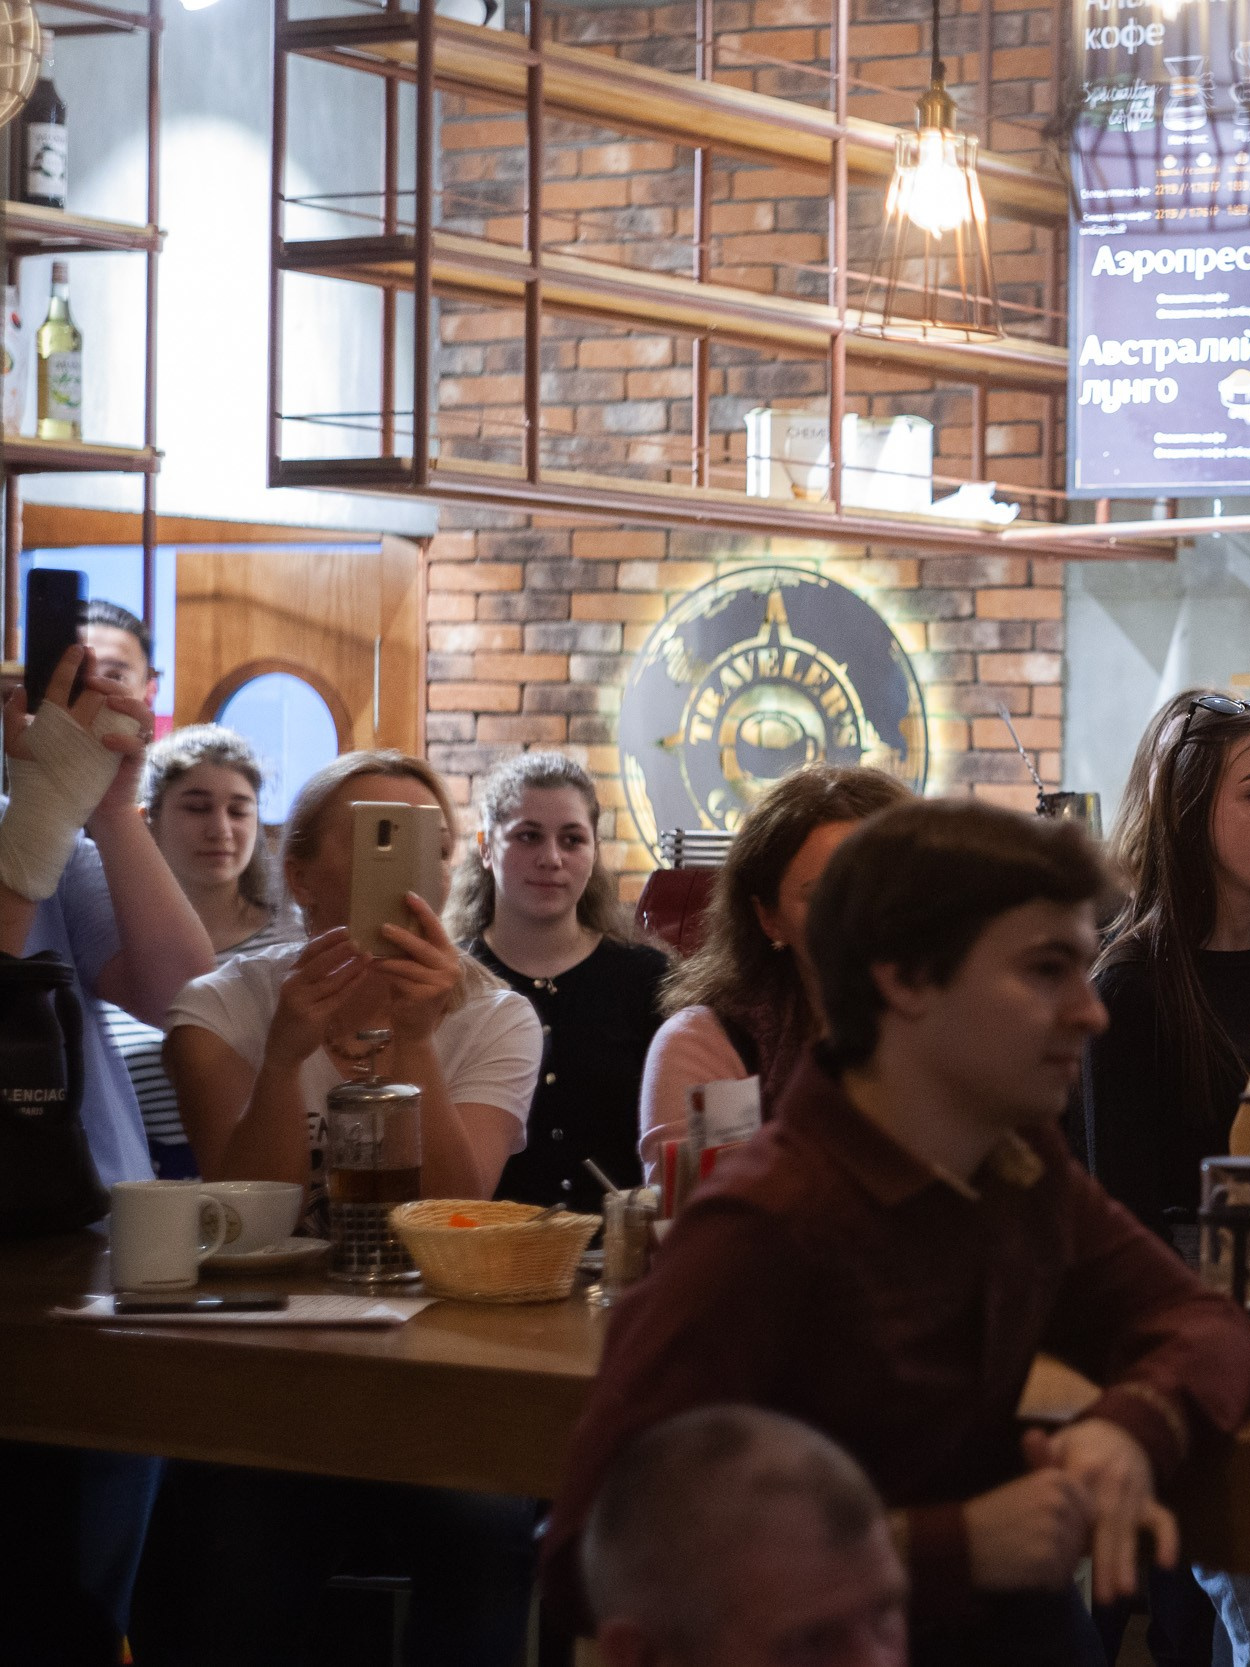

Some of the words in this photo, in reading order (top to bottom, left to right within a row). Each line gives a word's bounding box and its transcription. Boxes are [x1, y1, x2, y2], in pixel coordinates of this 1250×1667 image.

[1085, 17, 1166, 55] кофе
[1078, 377, 1179, 413] лунго
[688, 647, 858, 747] TRAVELERS
